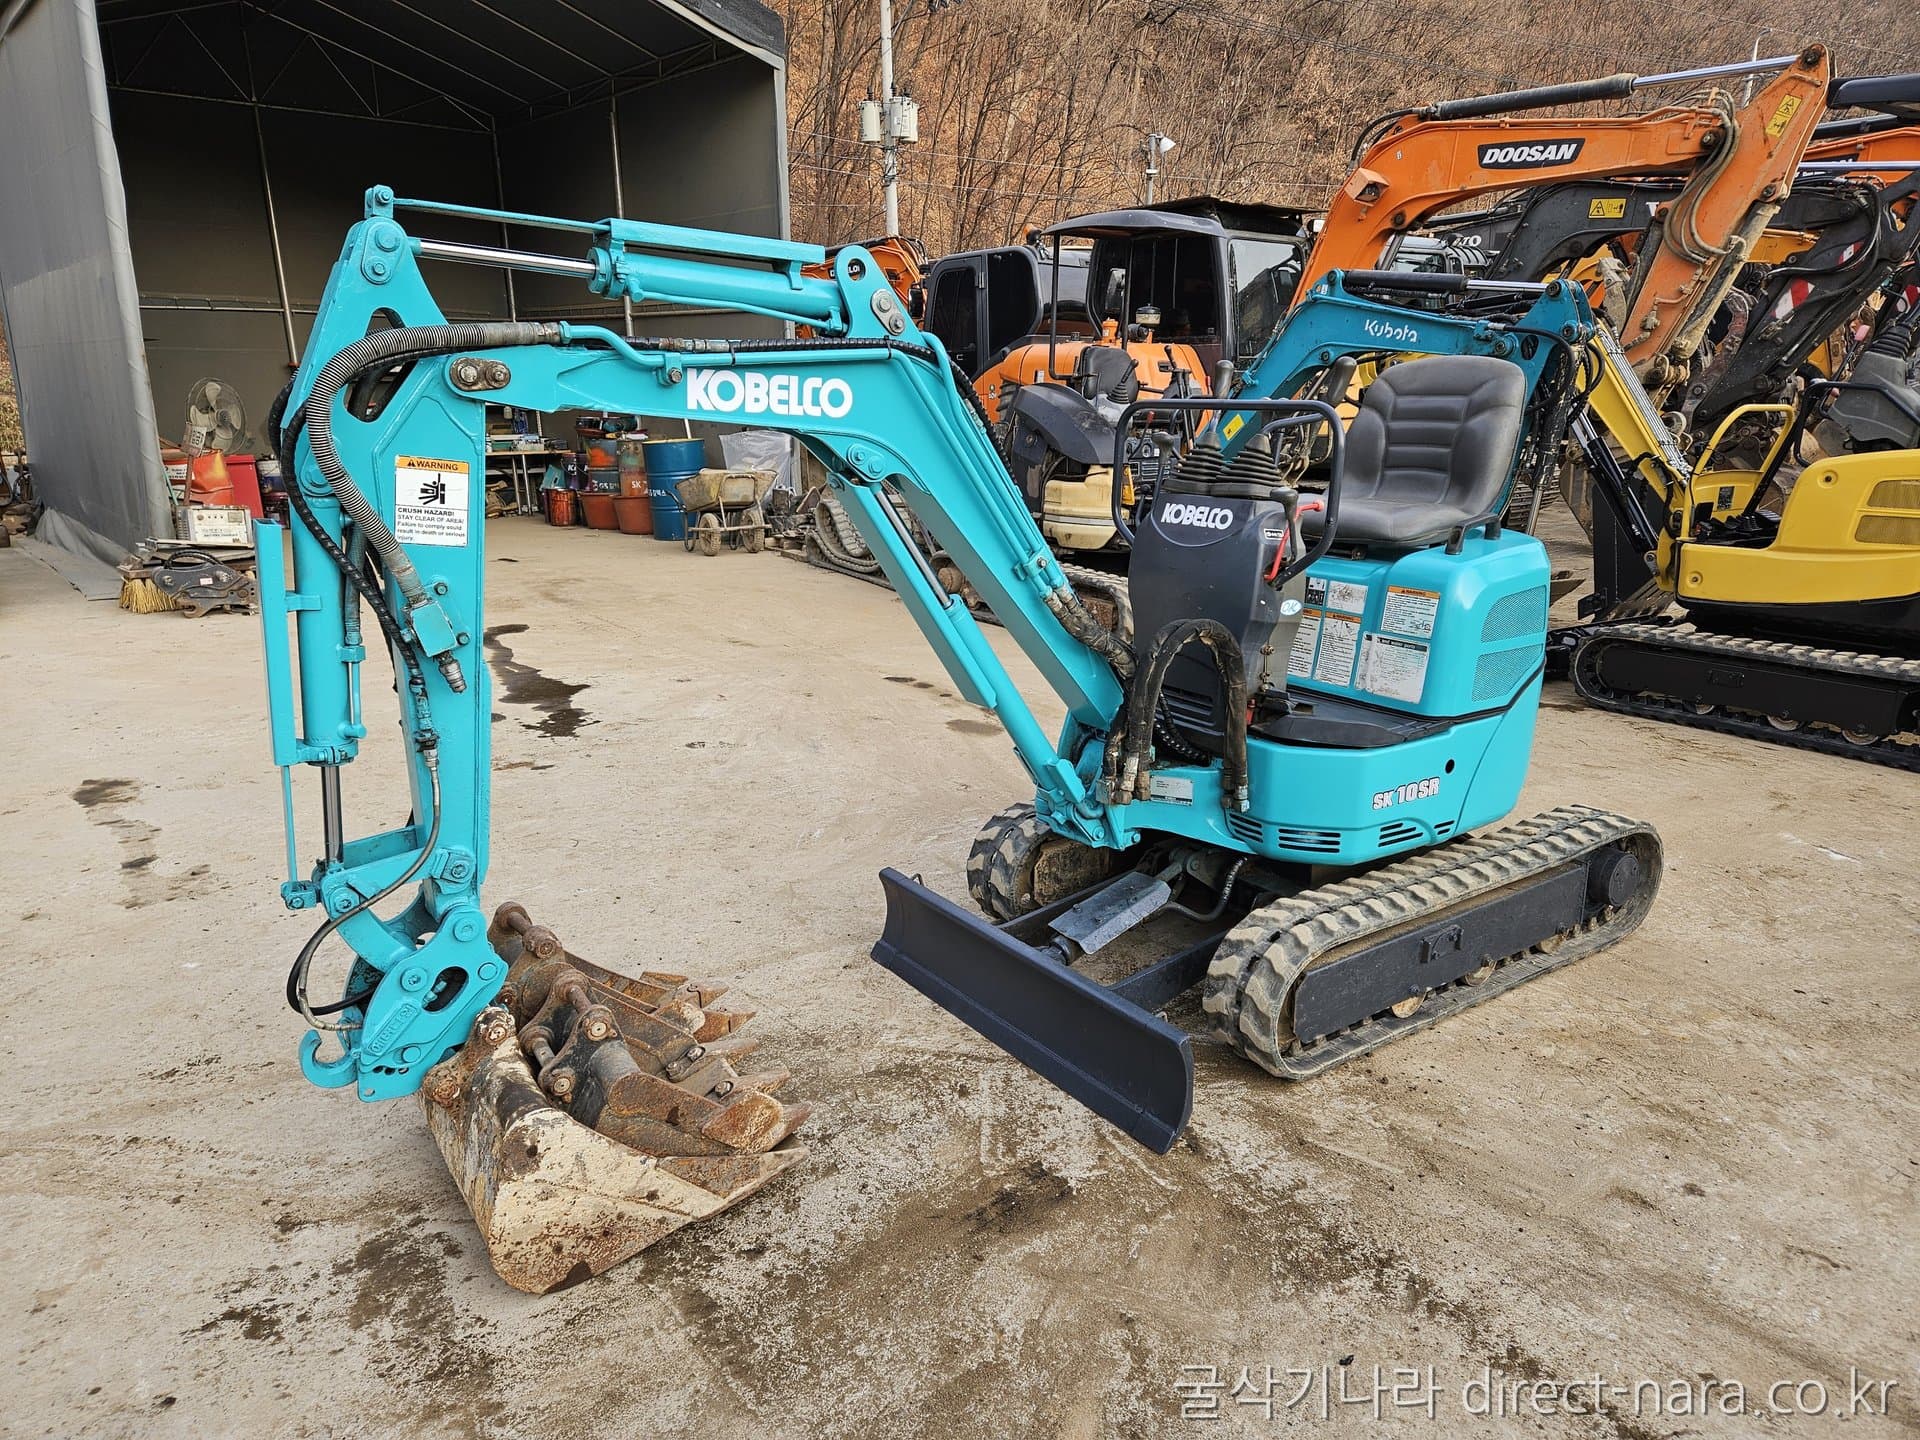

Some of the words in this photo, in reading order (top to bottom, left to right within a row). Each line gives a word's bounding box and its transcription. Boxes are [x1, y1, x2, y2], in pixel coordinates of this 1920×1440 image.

[1482, 144, 1577, 164] DOOSAN
[1364, 319, 1418, 343] Kubota
[686, 367, 854, 419] KOBELCO
[416, 460, 459, 471] WARNING
[1161, 503, 1234, 530] KOBELCO
[1372, 789, 1395, 811] SK
[1395, 776, 1440, 805] 10SR
